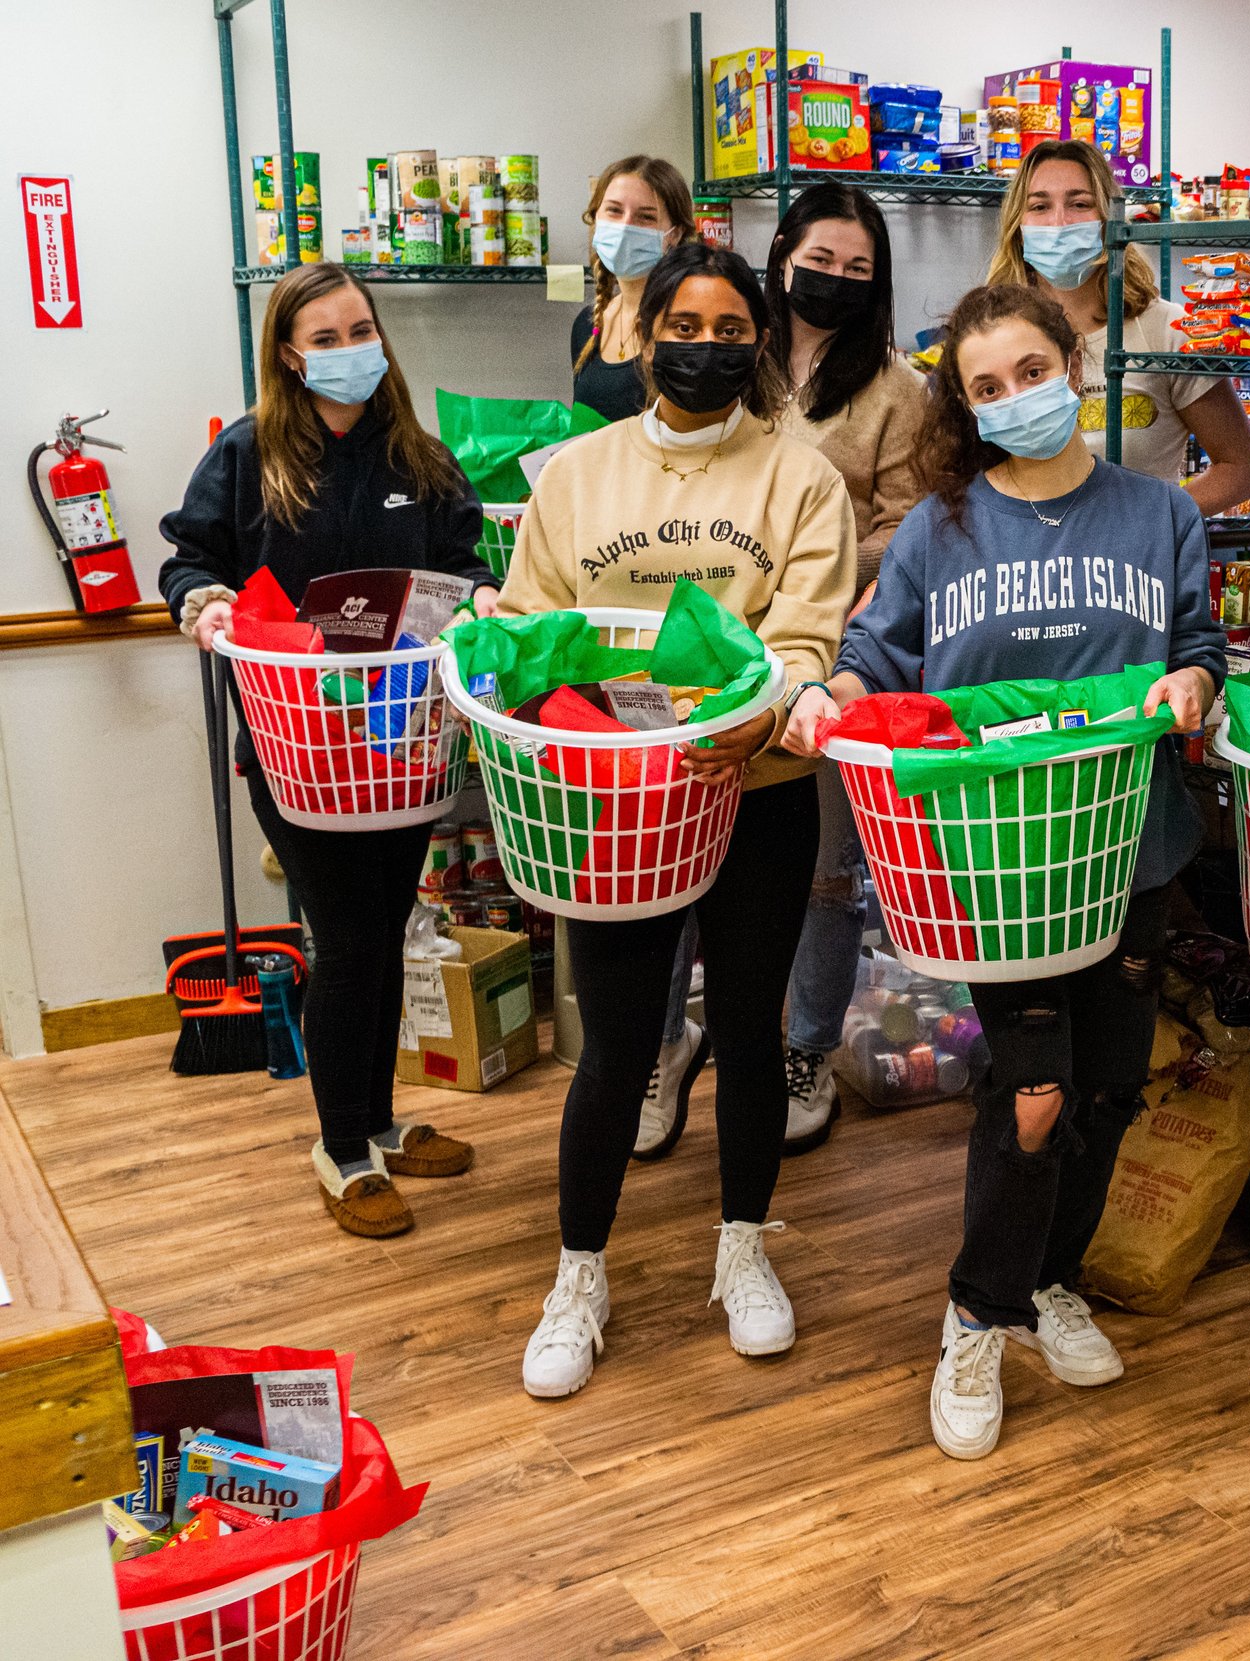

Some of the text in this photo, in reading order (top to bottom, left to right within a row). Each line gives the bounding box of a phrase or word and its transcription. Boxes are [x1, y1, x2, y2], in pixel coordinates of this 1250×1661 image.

[803, 101, 850, 128] ROUND
[1133, 168, 1145, 178] 50
[30, 193, 64, 207] FIRE
[703, 227, 732, 240] SALSA
[44, 214, 62, 302] EXTINGUISHER
[389, 493, 408, 502] NIKE
[580, 518, 774, 582] Alpha Chi Omega
[706, 566, 736, 579] 1885
[416, 588, 441, 598] SINCE
[930, 556, 1166, 646] LONG BEACH ISLAND
[345, 604, 360, 612] ACI
[316, 620, 386, 630] INDEPENDENCE
[1017, 622, 1080, 640] NEW JERSEY
[613, 690, 652, 699] DEDICATED
[615, 696, 664, 704] INDEPENDENCE
[617, 702, 667, 712] SINCE 1986
[1152, 1111, 1216, 1144] POTATOES
[267, 1383, 314, 1391] DEDICATED
[268, 1390, 328, 1398] INDEPENDENCE
[269, 1397, 329, 1408] SINCE 1986
[205, 1475, 298, 1508] Idaho
